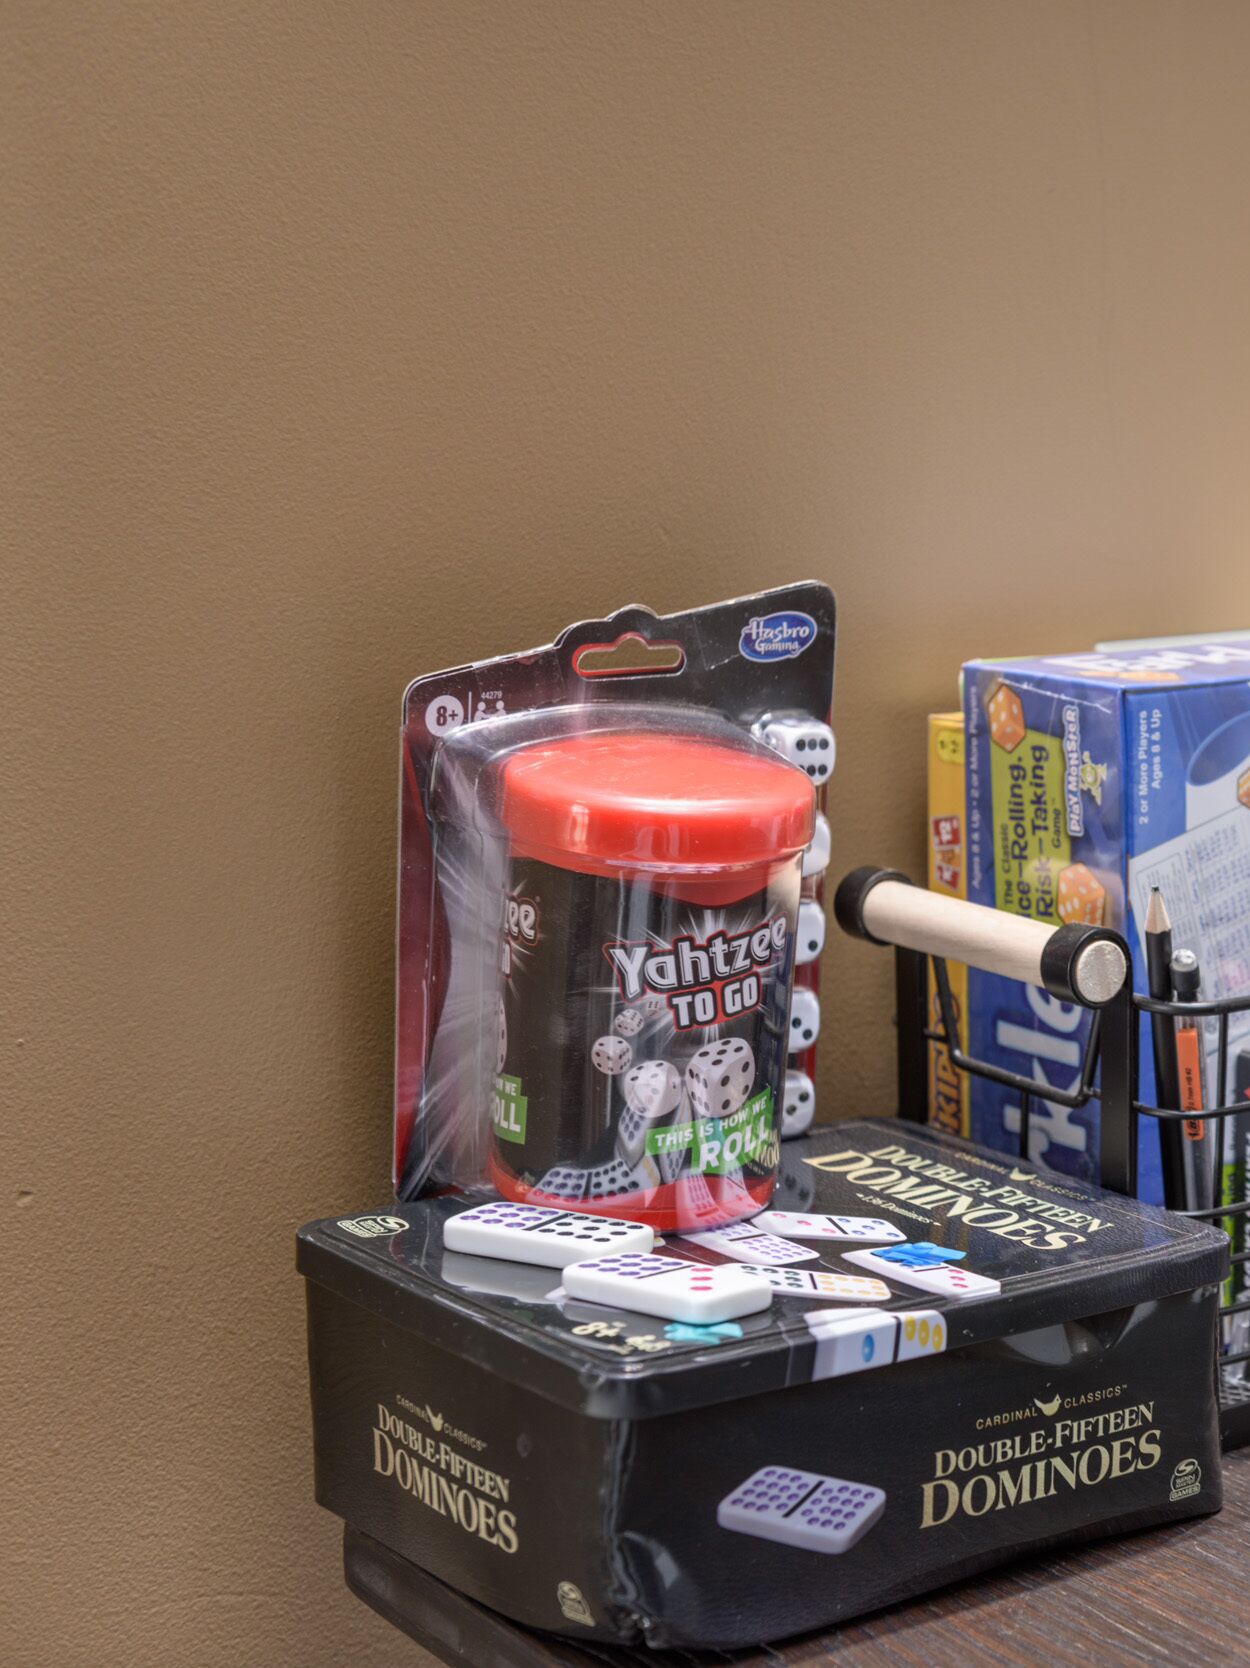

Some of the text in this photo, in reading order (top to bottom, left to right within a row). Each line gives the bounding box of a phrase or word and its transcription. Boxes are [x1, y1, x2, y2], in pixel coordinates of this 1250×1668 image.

[744, 620, 810, 642] Hasbro
[755, 638, 800, 655] Gaming
[436, 704, 460, 727] 8+
[1151, 709, 1162, 789] Ages 8 & Up
[1138, 710, 1149, 824] 2 or More Players
[1001, 823, 1014, 905] The Classic
[608, 916, 787, 1000] Yahtzee
[671, 975, 759, 1028] TO GO
[655, 1096, 768, 1148] THIS IS HOW WE
[699, 1115, 769, 1173] ROLL
[801, 1149, 1087, 1251] DOMINOES
[867, 1144, 1115, 1234] DOUBLE-FIFTEEN
[377, 1402, 511, 1504] DOUBLE-FIFTEEN
[934, 1400, 1156, 1479] DOUBLE-FIFTEEN
[975, 1406, 1039, 1431] CARDINAL
[371, 1426, 520, 1555] DOMINOES
[919, 1428, 1163, 1530] DOMINOES
